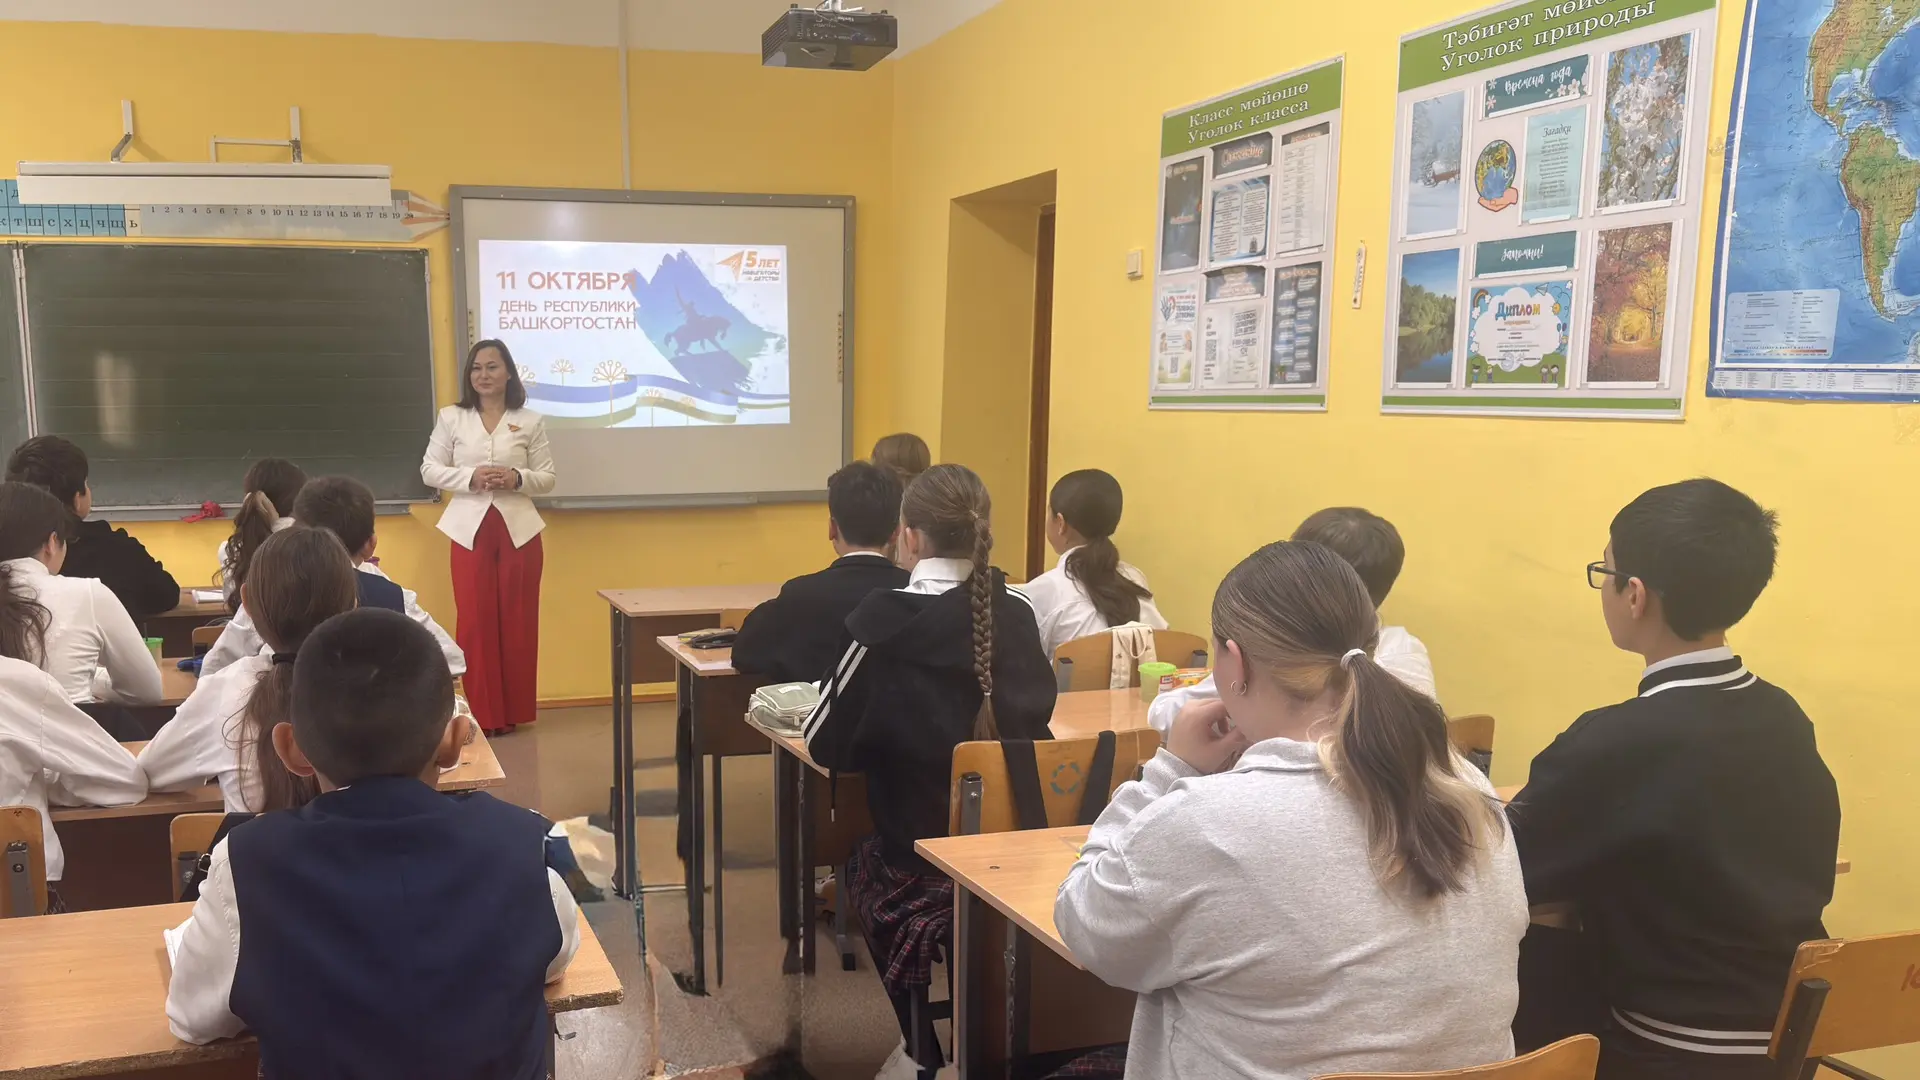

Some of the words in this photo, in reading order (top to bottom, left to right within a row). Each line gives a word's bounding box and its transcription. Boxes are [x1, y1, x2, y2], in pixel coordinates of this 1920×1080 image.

[1442, 12, 1534, 50] Тәбиғәт
[1543, 0, 1615, 20] мөй
[1440, 38, 1523, 71] Уголок
[1533, 1, 1656, 46] природы
[1189, 106, 1234, 128] Класс
[1240, 83, 1309, 113] мөйөшө
[1188, 120, 1243, 143] Уголок
[1250, 100, 1309, 126] класса
[746, 250, 758, 268] 5
[758, 258, 780, 268] ЛЕТ
[496, 271, 516, 290] 11
[527, 271, 636, 291] ОКТЯБРЯ
[499, 300, 537, 314] ДЕНЬ
[544, 300, 637, 312] РЕСПУБЛИКИ
[1495, 302, 1541, 321] Диплом
[499, 316, 637, 330] БАШКОРТОСТАН
